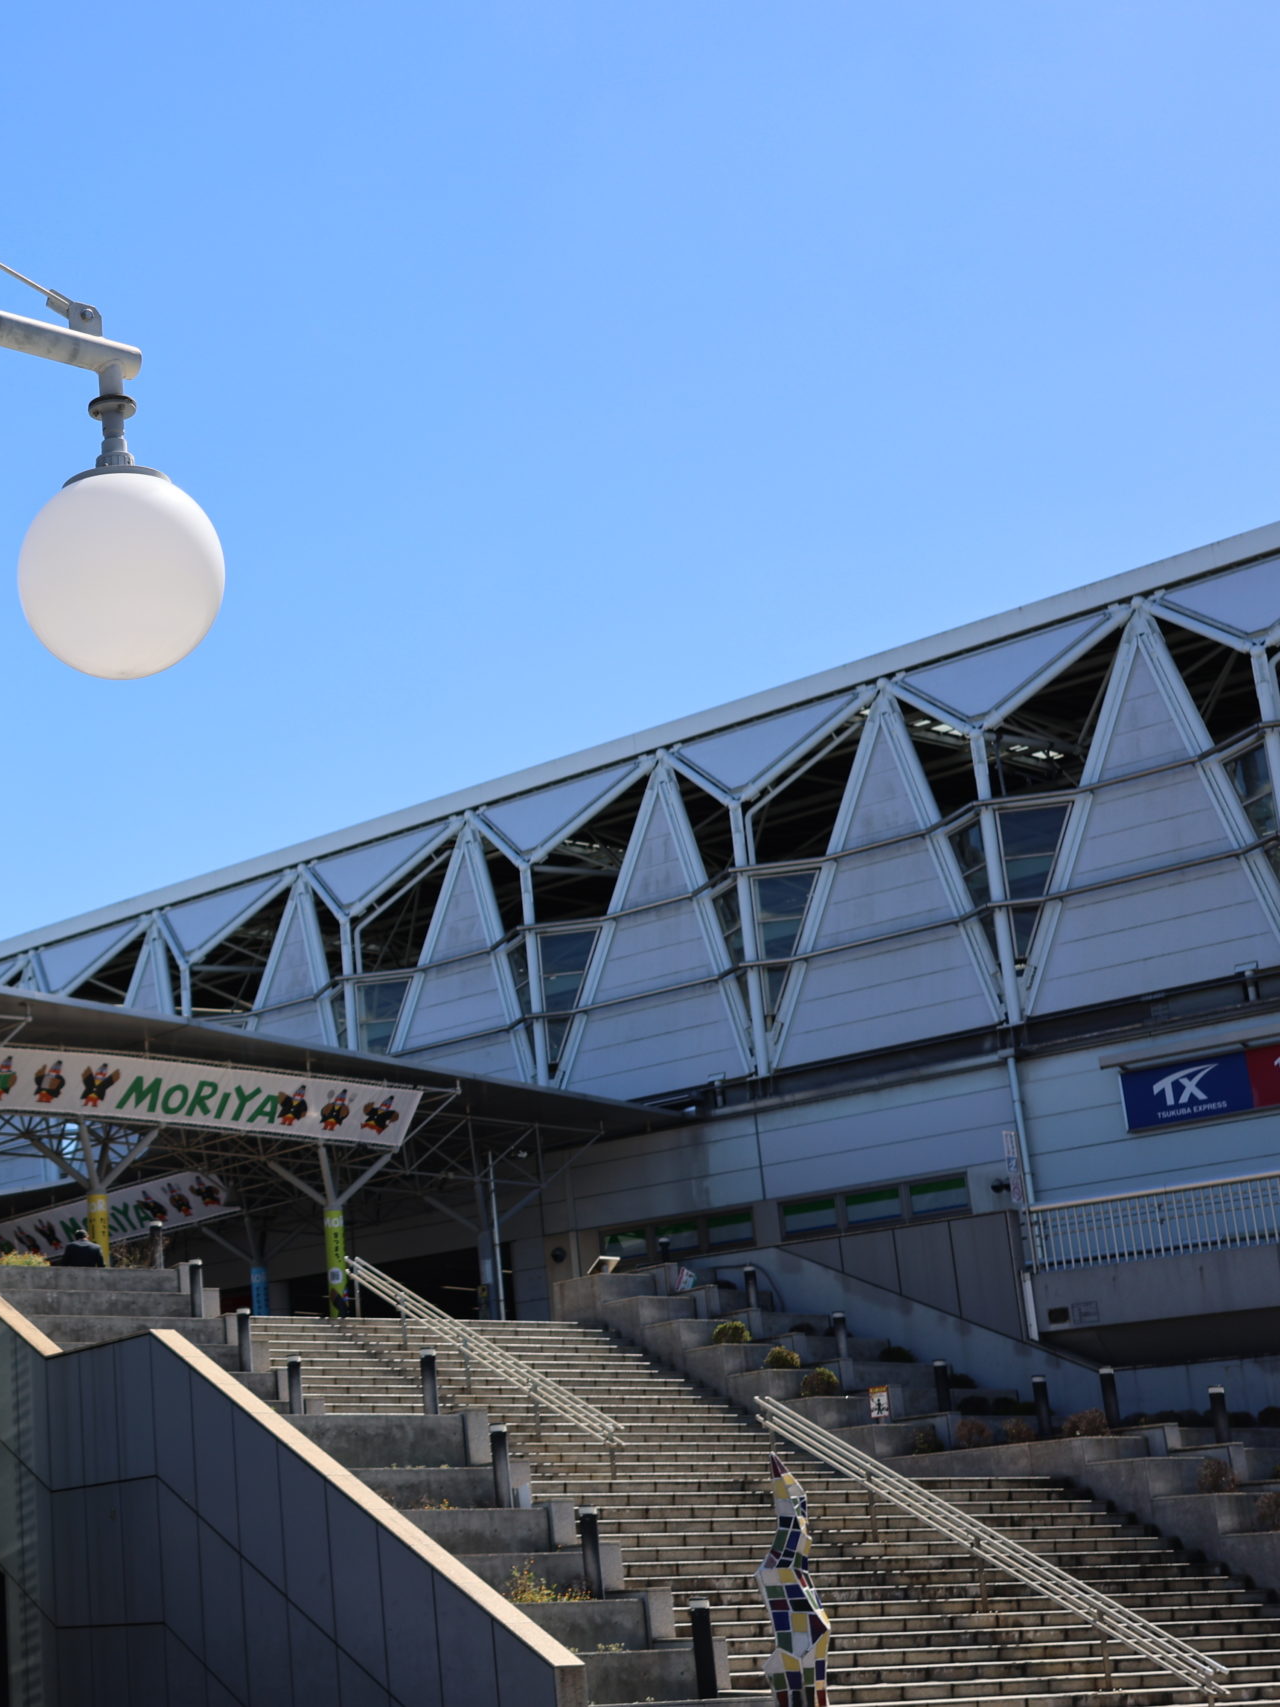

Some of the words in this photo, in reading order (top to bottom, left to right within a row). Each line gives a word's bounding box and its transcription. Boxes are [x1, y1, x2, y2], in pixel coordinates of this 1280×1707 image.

[115, 1076, 280, 1124] MORIYA
[1153, 1063, 1218, 1106] TX
[1157, 1107, 1192, 1119] TSUKUBA
[1193, 1100, 1228, 1114] EXPRESS
[60, 1202, 154, 1241] MIYA
